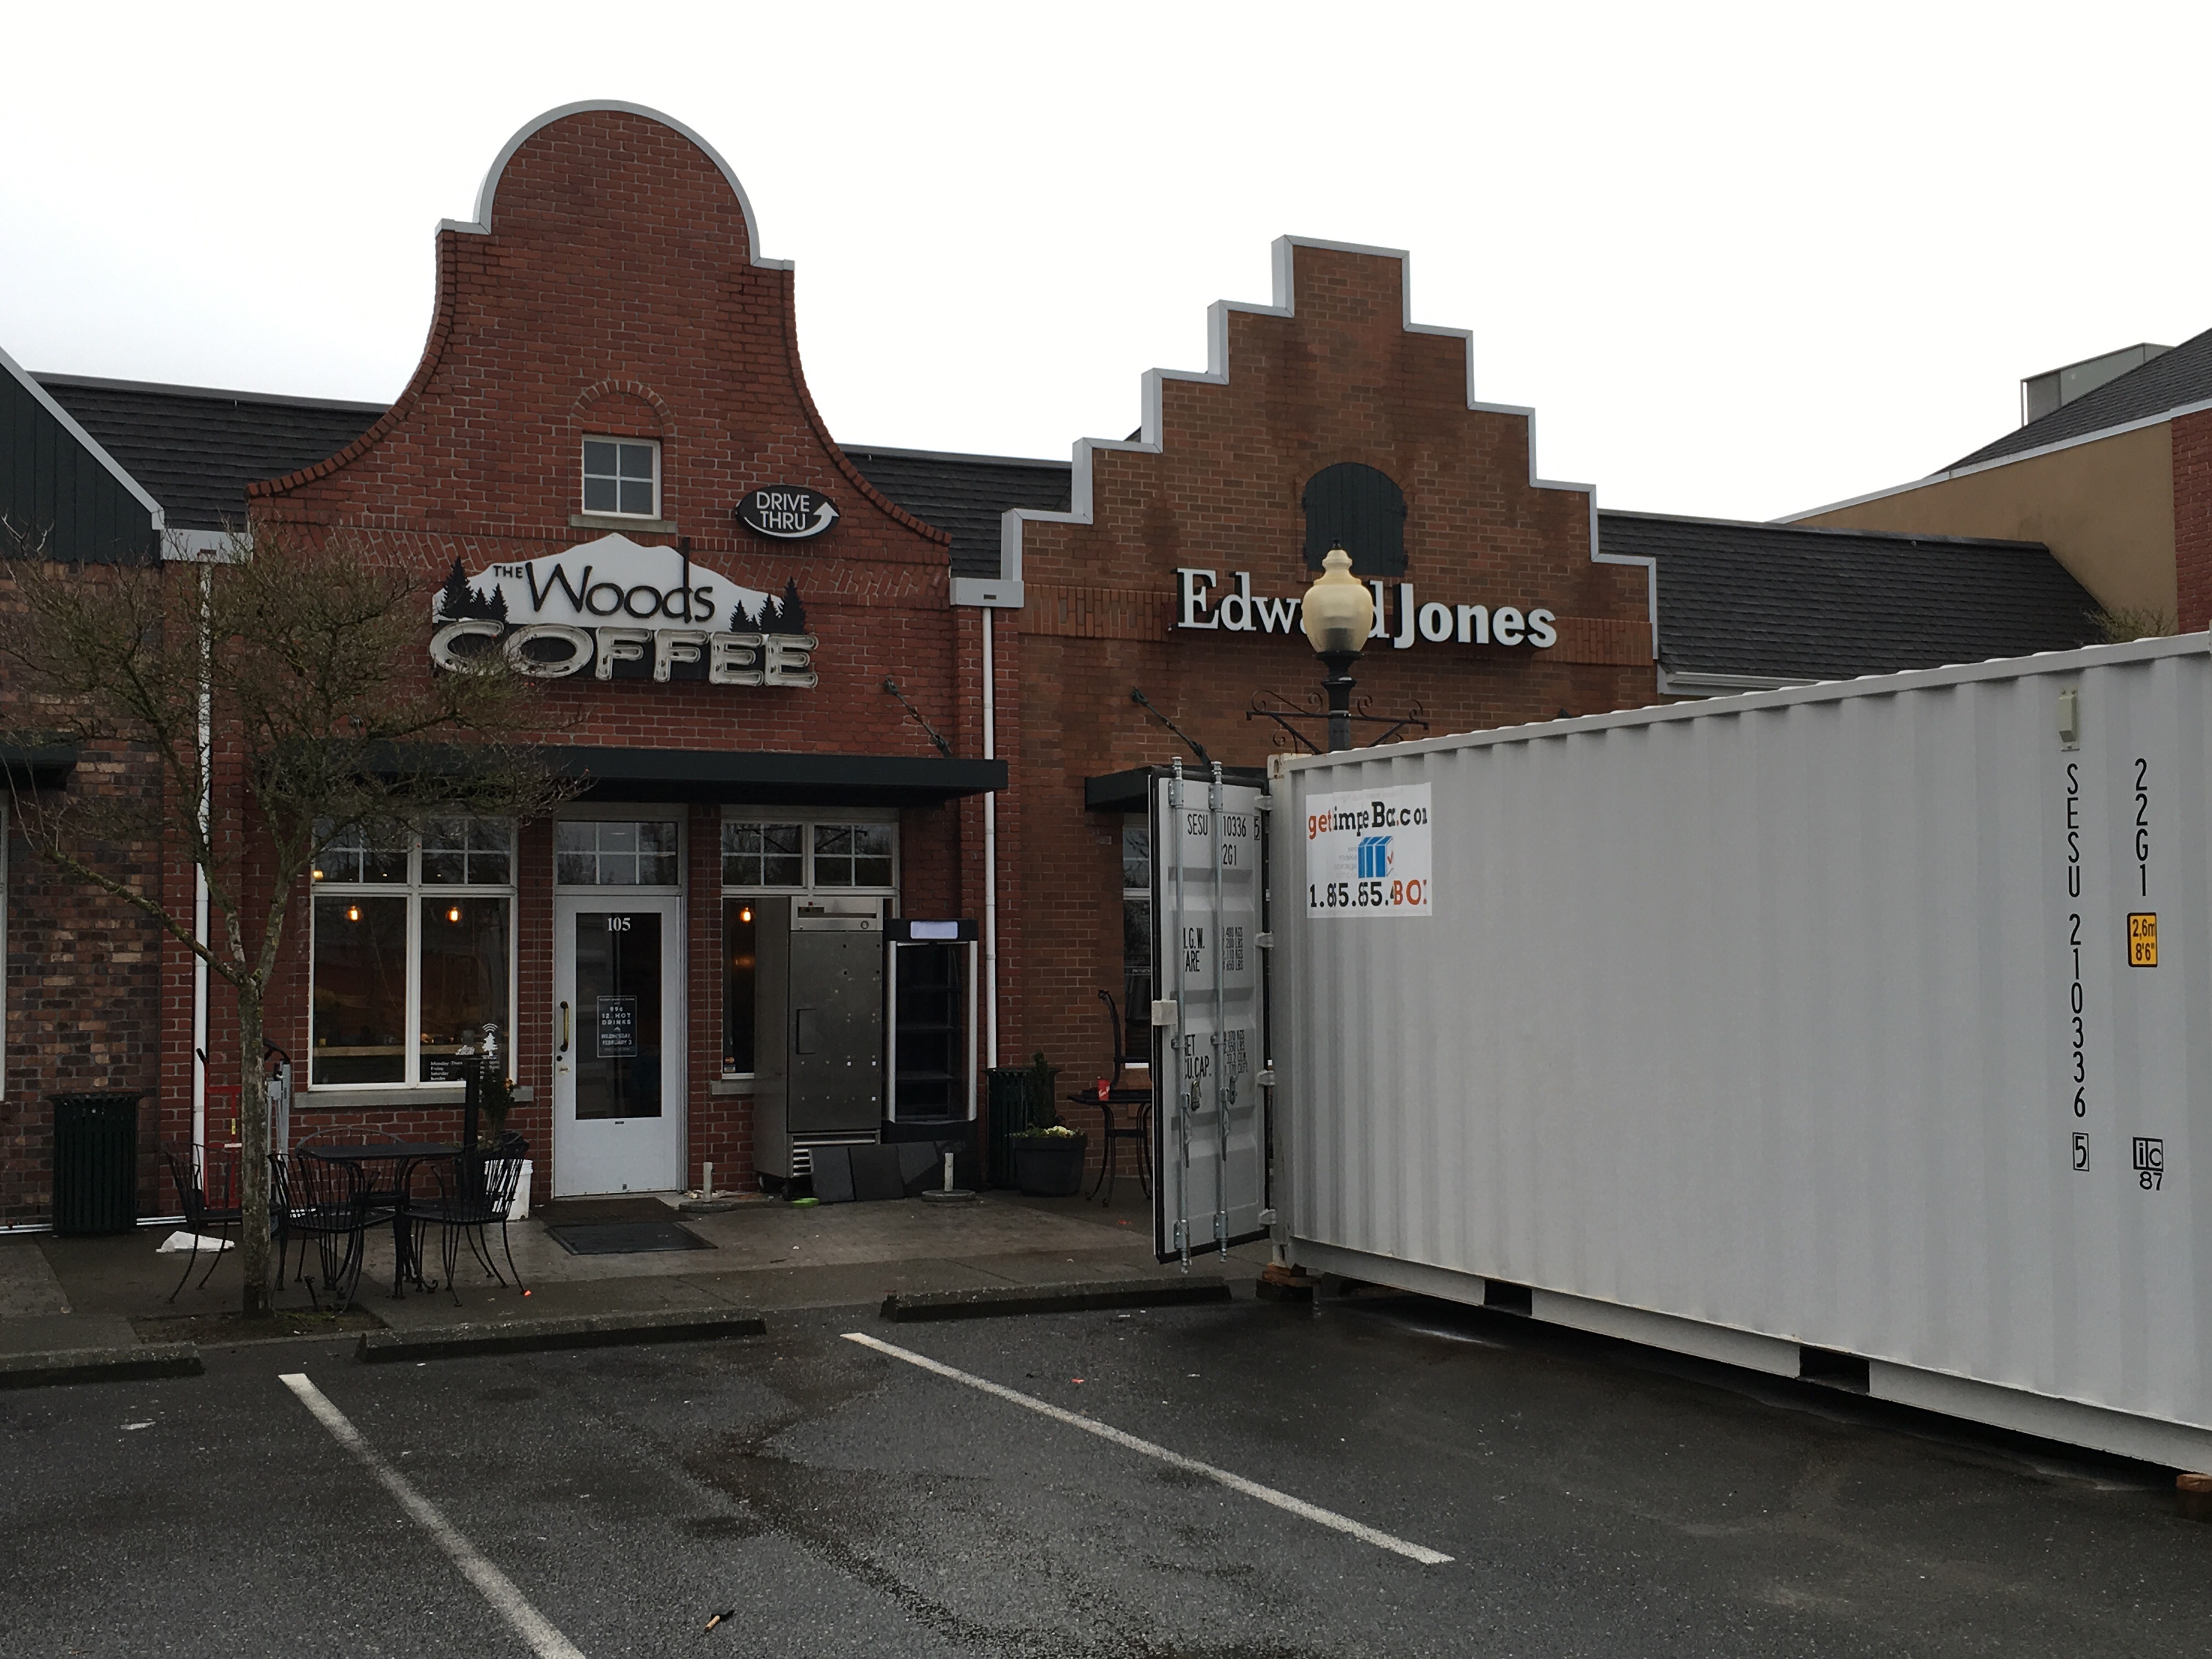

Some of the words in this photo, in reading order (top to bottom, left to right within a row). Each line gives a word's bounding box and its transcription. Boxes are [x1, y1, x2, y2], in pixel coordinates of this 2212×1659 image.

[757, 492, 810, 512] DRIVE
[760, 511, 806, 531] THRU
[493, 566, 523, 579] THE
[525, 537, 715, 623] Woods
[1176, 568, 1390, 639] Edwd
[1394, 583, 1558, 648] Jones
[430, 619, 819, 689] COFFEE
[1188, 814, 1208, 836] SESU
[1223, 816, 1246, 837] 10336
[1222, 844, 1237, 865] 2G1
[607, 917, 631, 932] 105
[2132, 918, 2155, 940] 2,6m
[1183, 950, 1200, 972] ARE
[2140, 1171, 2163, 1191] 87
